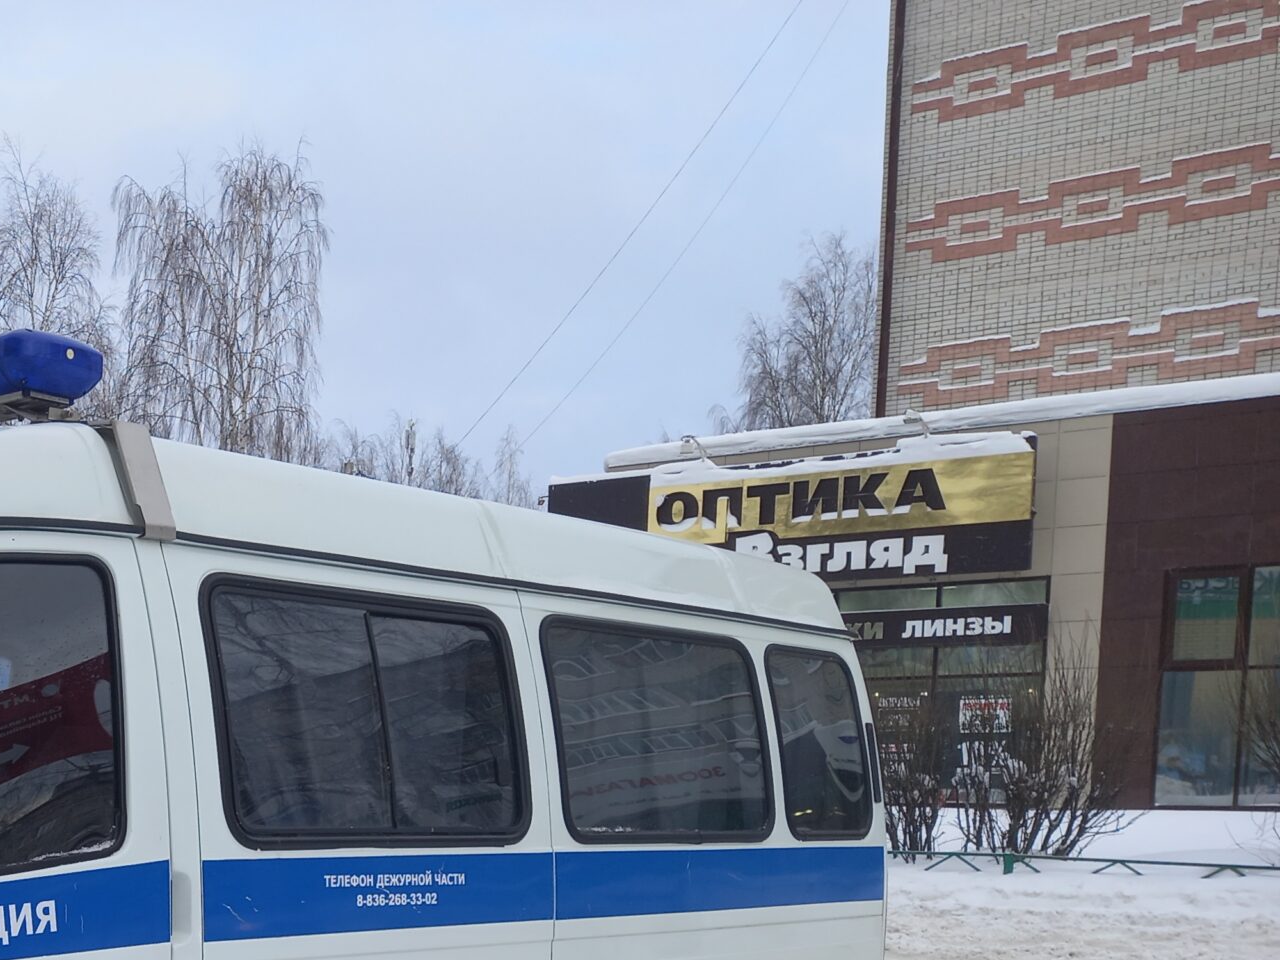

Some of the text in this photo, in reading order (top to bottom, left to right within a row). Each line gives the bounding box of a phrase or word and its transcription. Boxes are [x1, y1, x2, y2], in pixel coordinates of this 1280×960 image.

[656, 467, 947, 532] ОПТИКА
[735, 532, 949, 576] Взгляд
[901, 615, 1013, 639] ЛИНЗЫ
[323, 870, 466, 889] ТЕЛЕФОН ДЕЖУРНОЙ ЧАСТИ
[356, 892, 438, 907] 8-836-268-33-02
